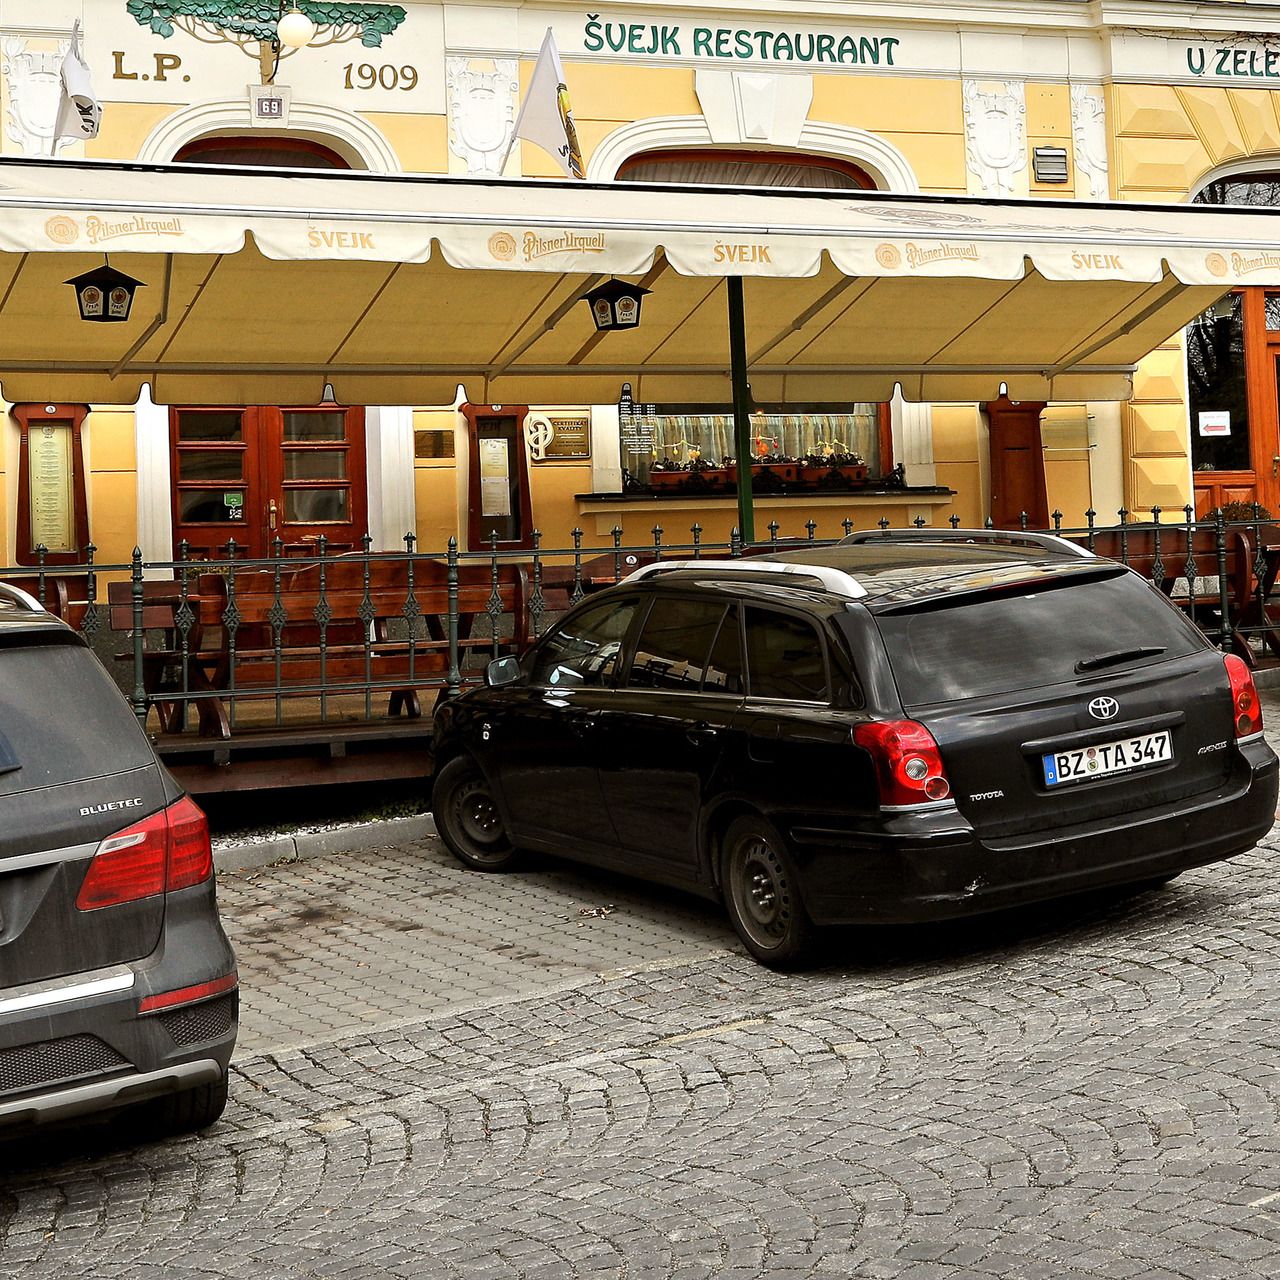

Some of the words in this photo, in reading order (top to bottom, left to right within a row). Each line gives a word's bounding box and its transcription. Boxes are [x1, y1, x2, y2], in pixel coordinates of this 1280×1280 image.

[583, 13, 682, 56] ŠVEJK
[693, 27, 900, 66] RESTAURANT
[111, 50, 192, 83] L.P.
[1186, 47, 1206, 75] U
[342, 62, 419, 91] 1909
[262, 101, 278, 113] 69
[86, 215, 135, 245] Pilsner
[133, 216, 184, 236] Urquell
[308, 226, 376, 250] ŠVEJK
[523, 231, 566, 262] Pilsner
[564, 231, 605, 253] Urquell
[713, 240, 772, 264] ŠVEJK
[906, 242, 944, 269] Pilsner
[941, 243, 980, 262] Urquell
[1071, 250, 1124, 270] ŠVEJK
[1056, 751, 1086, 778] BZ
[1099, 743, 1127, 769] TA
[1130, 735, 1167, 763] 347
[79, 797, 143, 816] BLUETEC
[969, 789, 1005, 802] TOYOTA
